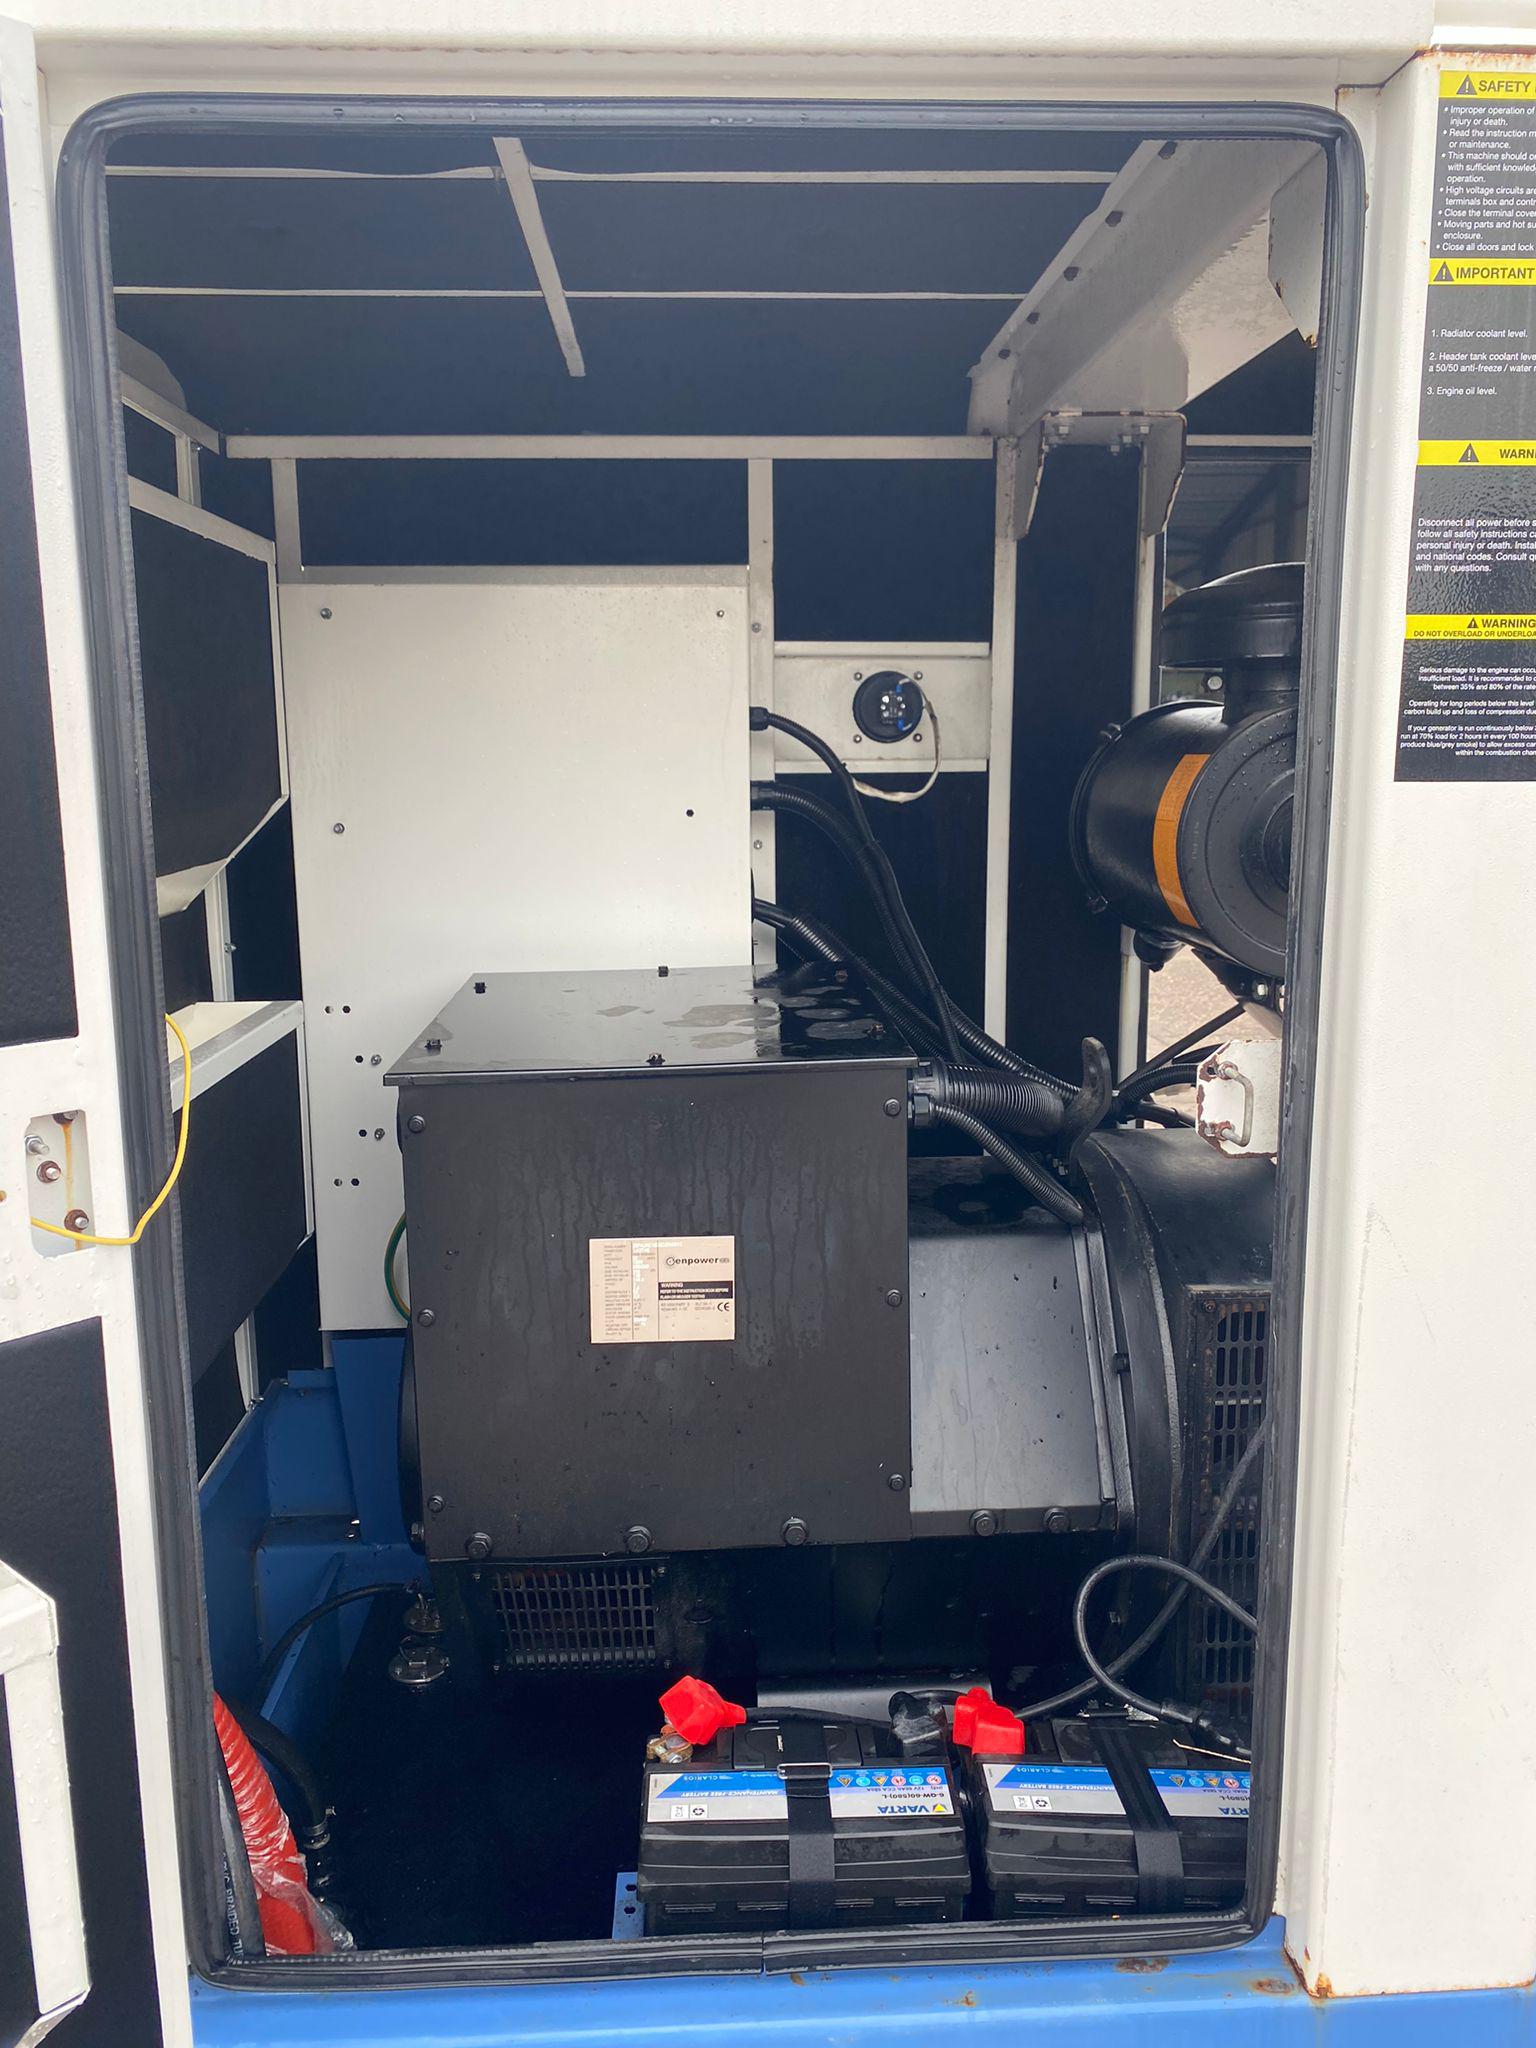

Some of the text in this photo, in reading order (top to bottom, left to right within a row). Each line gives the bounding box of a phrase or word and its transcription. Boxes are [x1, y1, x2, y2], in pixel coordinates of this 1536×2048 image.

[1479, 81, 1530, 92] SAFETY
[1450, 106, 1486, 115] Improper
[1488, 107, 1524, 115] operation
[1450, 118, 1471, 127] injury
[1449, 129, 1470, 137] Read
[1459, 141, 1510, 149] maintenance.
[1466, 164, 1501, 172] sufficient
[1446, 187, 1463, 195] High
[1466, 187, 1494, 195] voltage
[1446, 198, 1481, 206] terminals
[1483, 198, 1497, 206] box
[1499, 198, 1514, 206] and
[1444, 209, 1466, 217] Close
[1444, 221, 1471, 229] Moving
[1442, 243, 1533, 251] Close all doors and lock
[1456, 268, 1535, 279] IMPORTANT
[1435, 364, 1458, 372] 50/50
[1460, 364, 1502, 372] anti-freeze
[1427, 387, 1434, 395] 3.
[1437, 387, 1463, 396] Engine
[1477, 387, 1497, 395] level.
[1418, 519, 1463, 527] Disconnect
[1476, 520, 1502, 528] power
[1504, 519, 1531, 527] before
[1454, 530, 1478, 539] safety
[1417, 542, 1451, 550] personal
[1453, 542, 1475, 550] injury
[1466, 553, 1493, 561] codes.
[1496, 553, 1527, 561] Consult
[1450, 565, 1491, 573] questions.
[1482, 619, 1536, 628] WARNING
[1409, 700, 1438, 708] Operating
[1486, 709, 1524, 717] compression
[877, 1805, 930, 1814] VARTA
[1218, 1807, 1249, 1815] RTA
